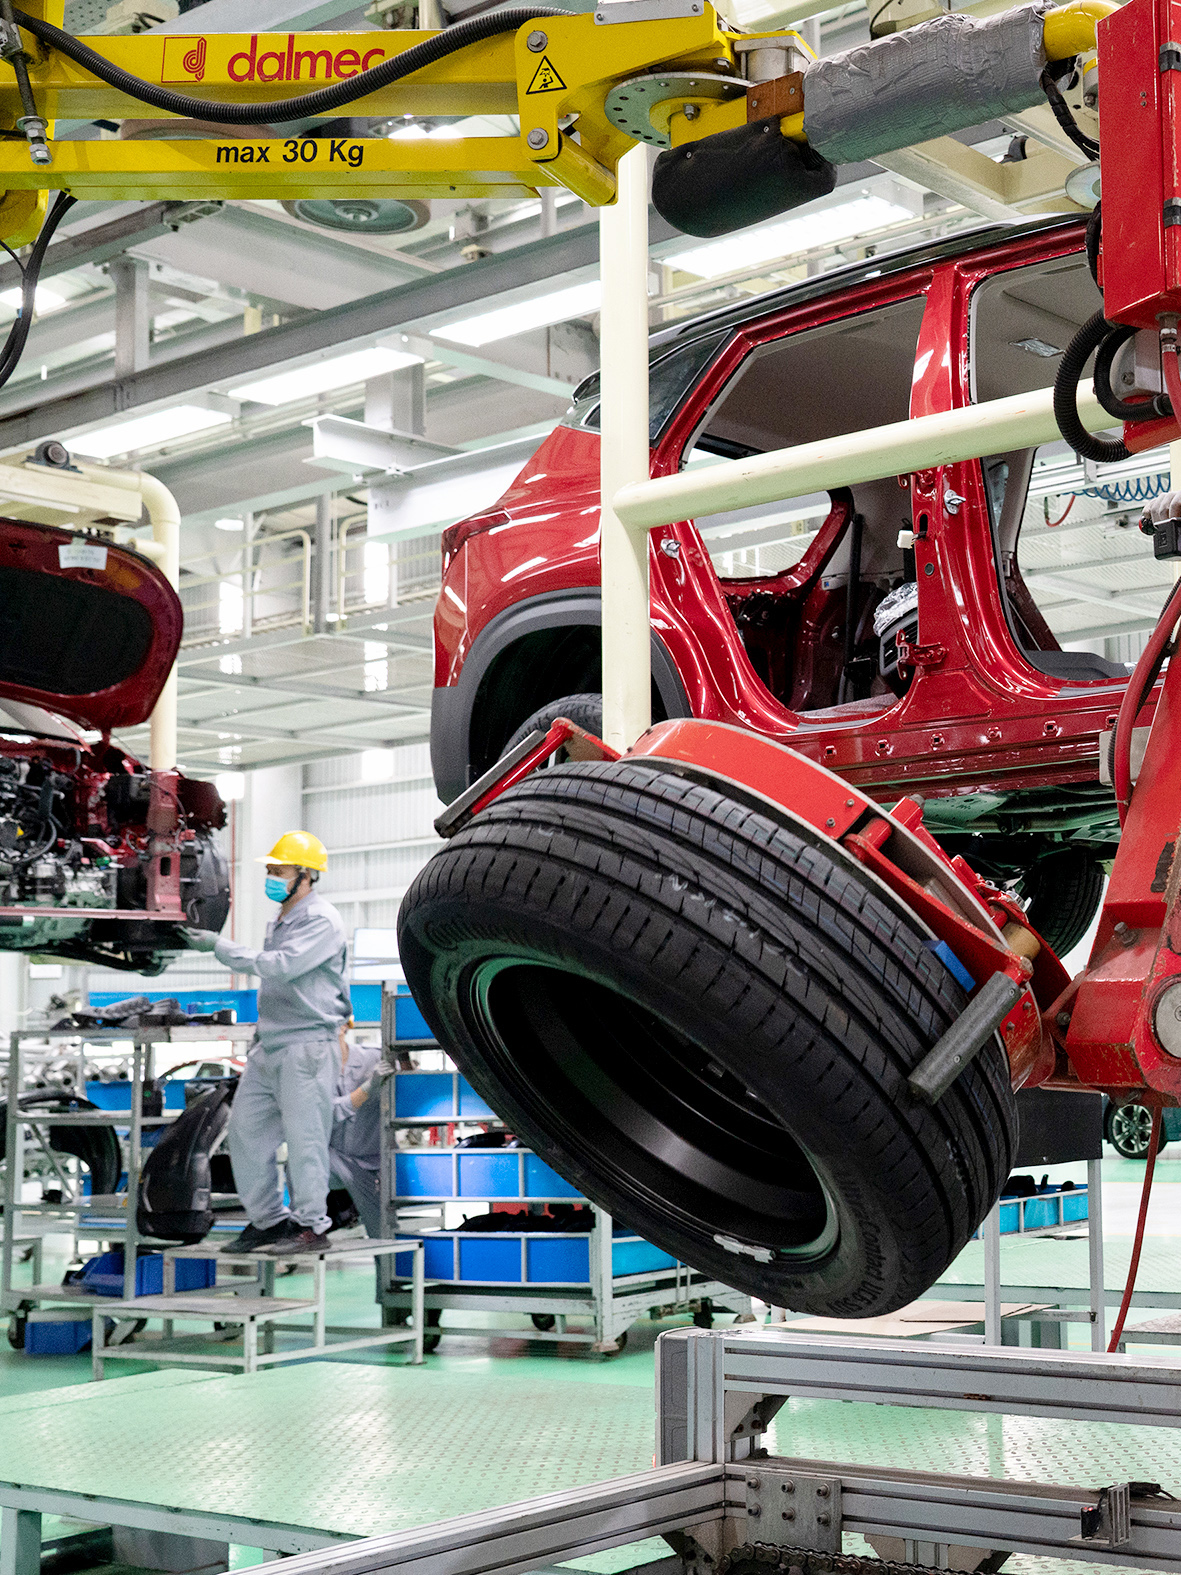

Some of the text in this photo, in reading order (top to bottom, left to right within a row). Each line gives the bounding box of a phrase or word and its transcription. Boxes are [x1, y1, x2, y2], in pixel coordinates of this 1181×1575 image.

[216, 139, 364, 167] max 30 Kg
